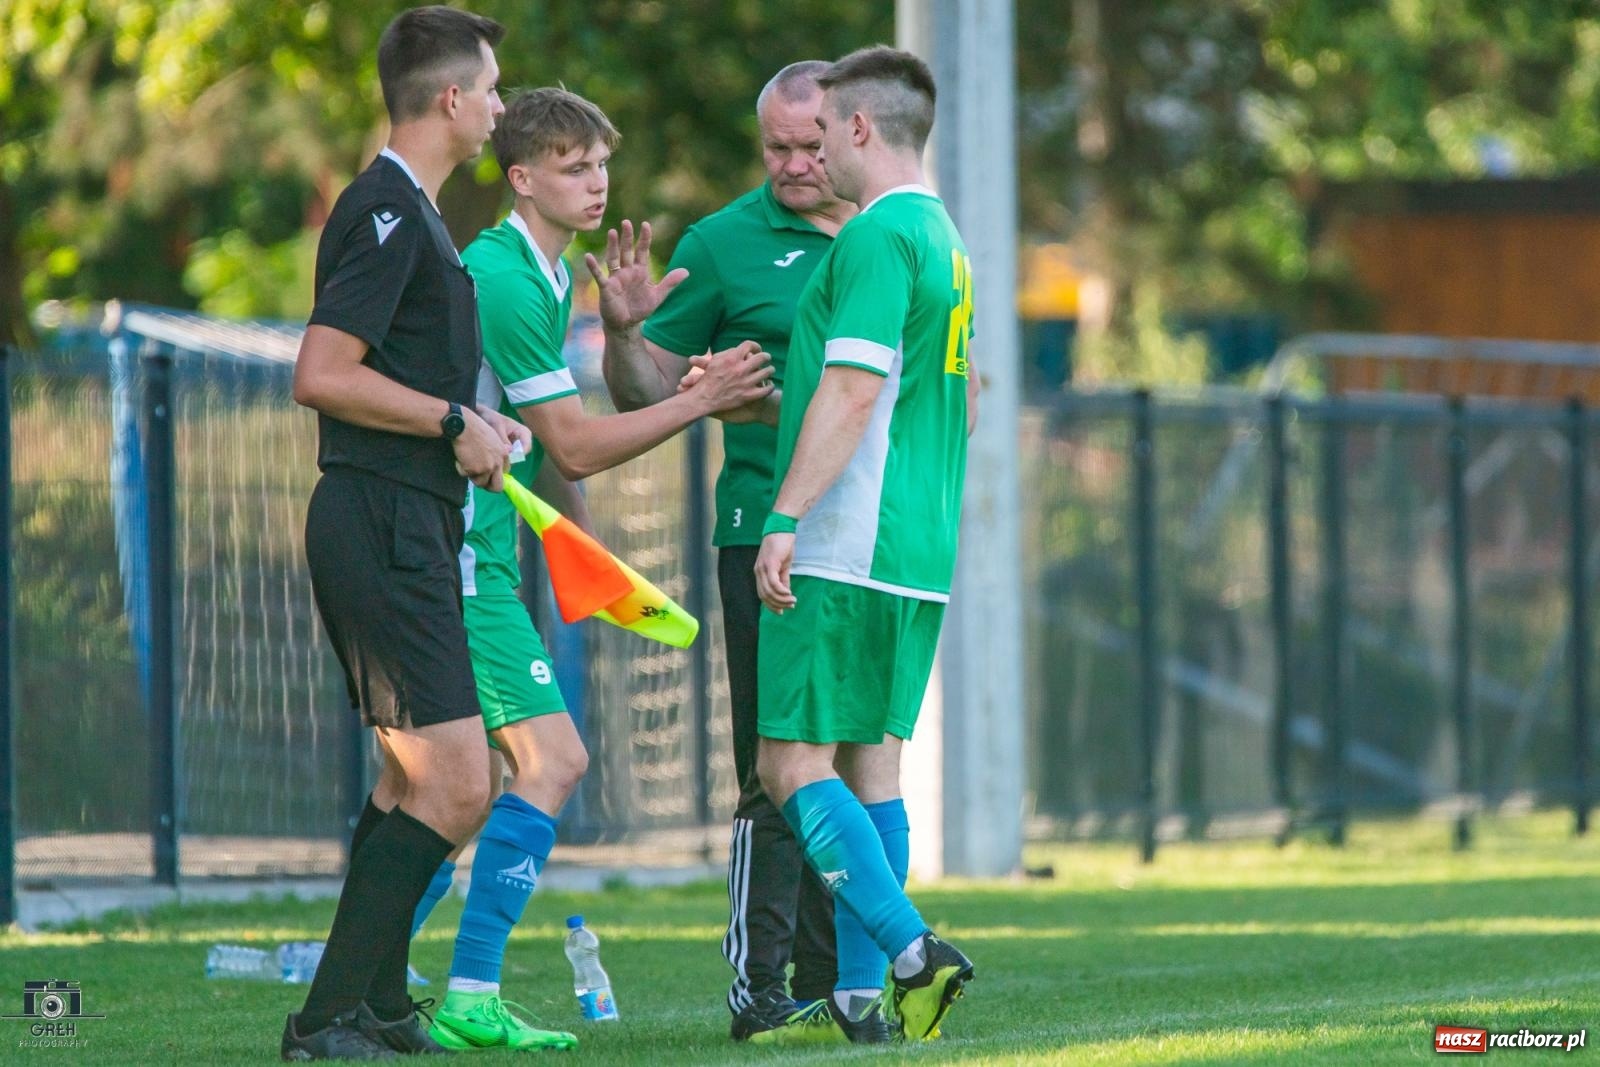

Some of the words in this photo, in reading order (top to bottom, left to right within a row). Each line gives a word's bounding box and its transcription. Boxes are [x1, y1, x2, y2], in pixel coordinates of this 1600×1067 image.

[732, 508, 742, 528] 3
[530, 660, 551, 685] 9
[496, 874, 535, 892] SELEC
